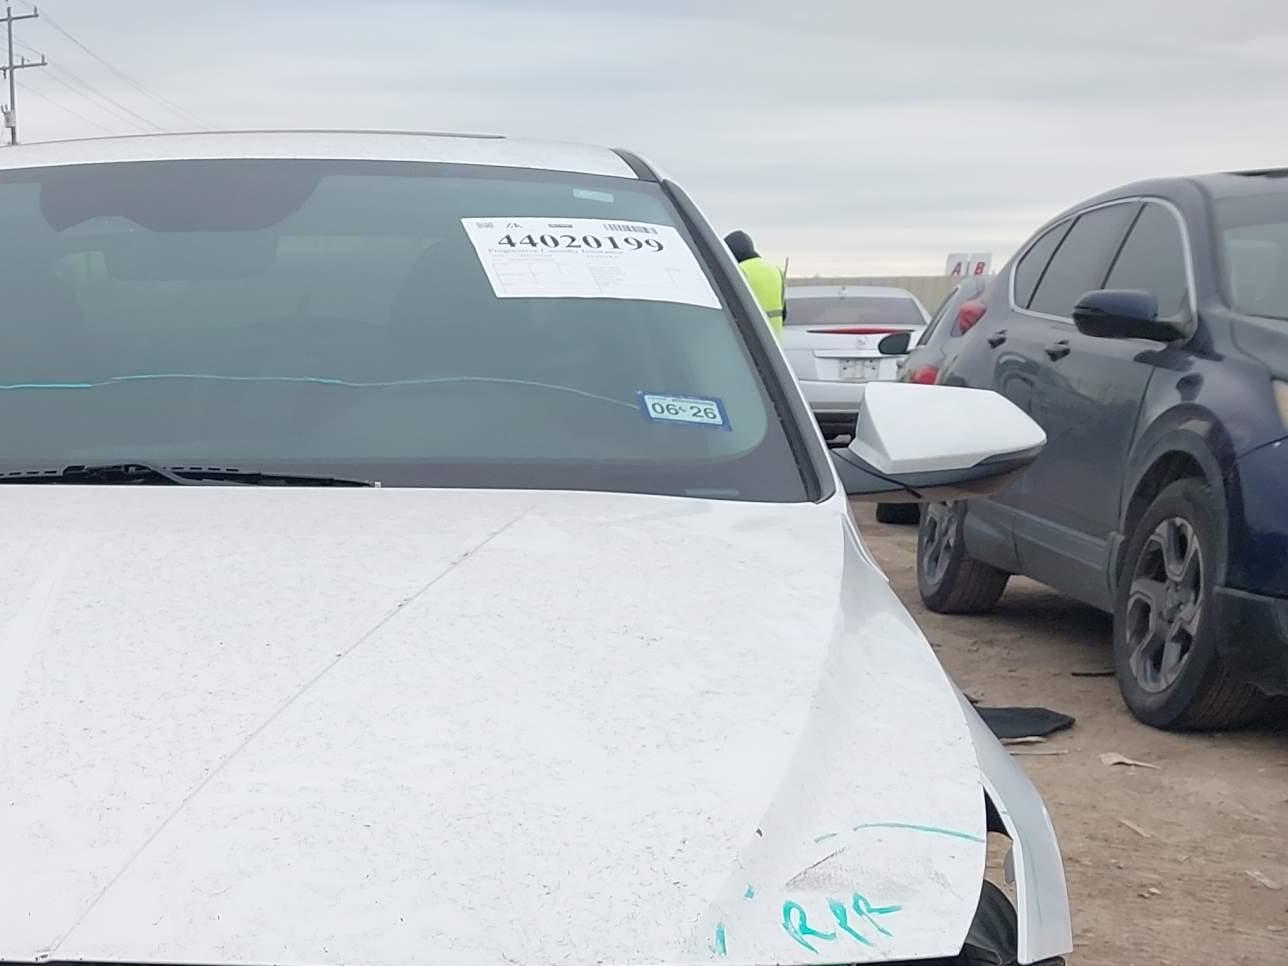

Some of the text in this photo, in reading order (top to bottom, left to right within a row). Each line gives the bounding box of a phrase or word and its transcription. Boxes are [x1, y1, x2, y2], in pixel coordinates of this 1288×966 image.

[497, 234, 664, 252] 44020199
[651, 402, 718, 420] 06 26
